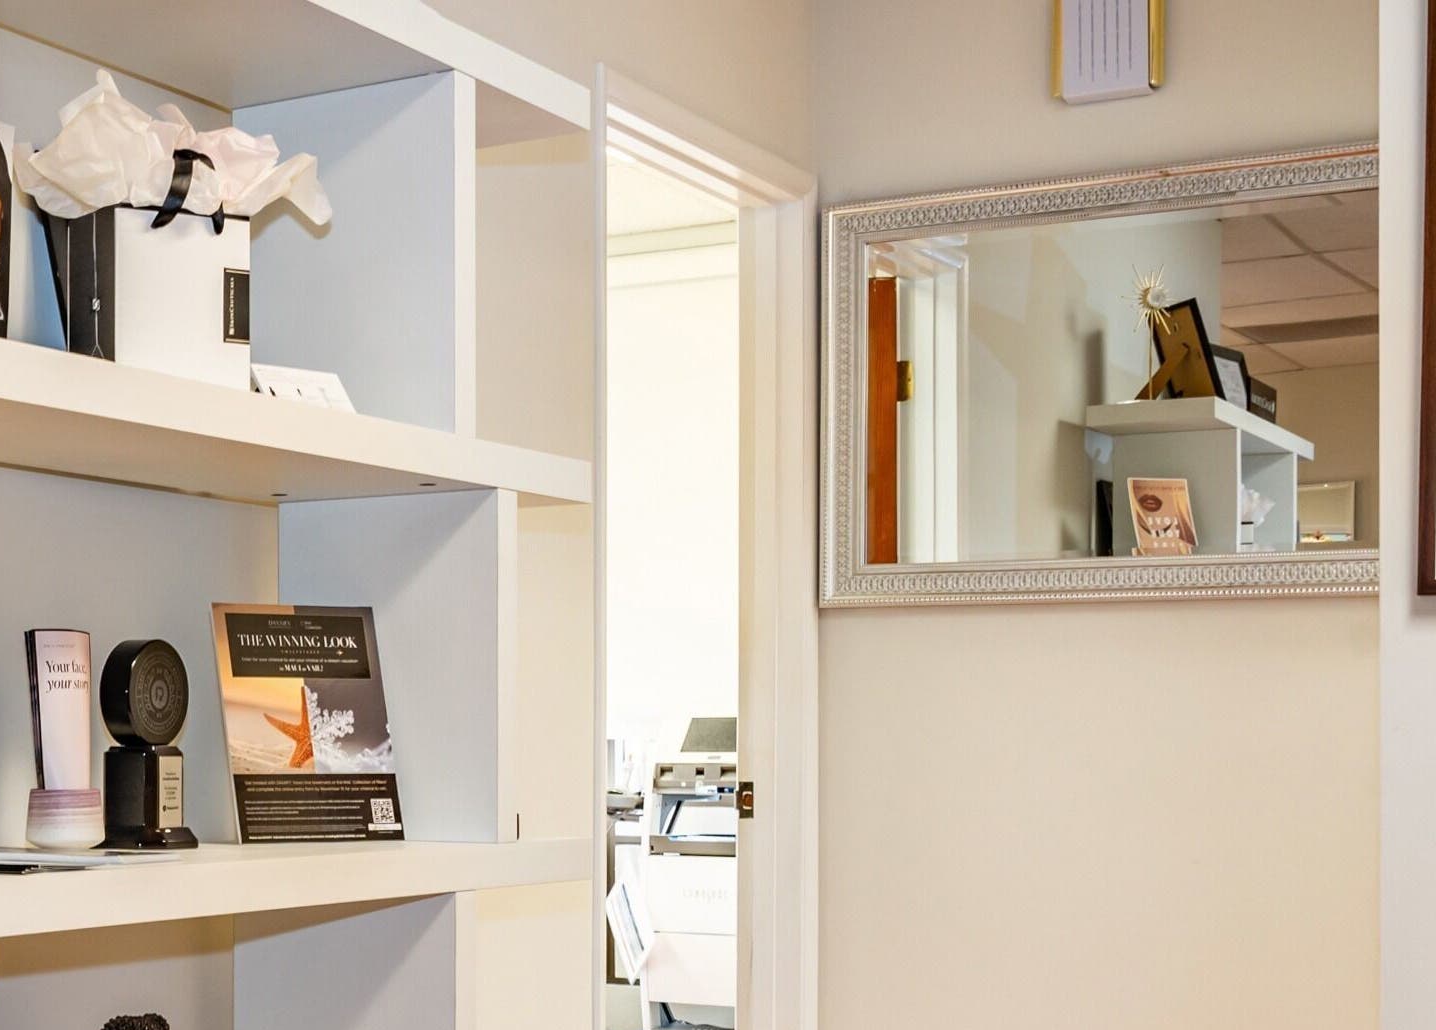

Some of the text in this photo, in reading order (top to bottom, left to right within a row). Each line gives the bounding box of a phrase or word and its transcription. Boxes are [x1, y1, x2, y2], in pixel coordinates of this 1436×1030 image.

[237, 634, 357, 648] THE WINNING LOOK
[45, 659, 70, 673] Your
[46, 679, 71, 693] your
